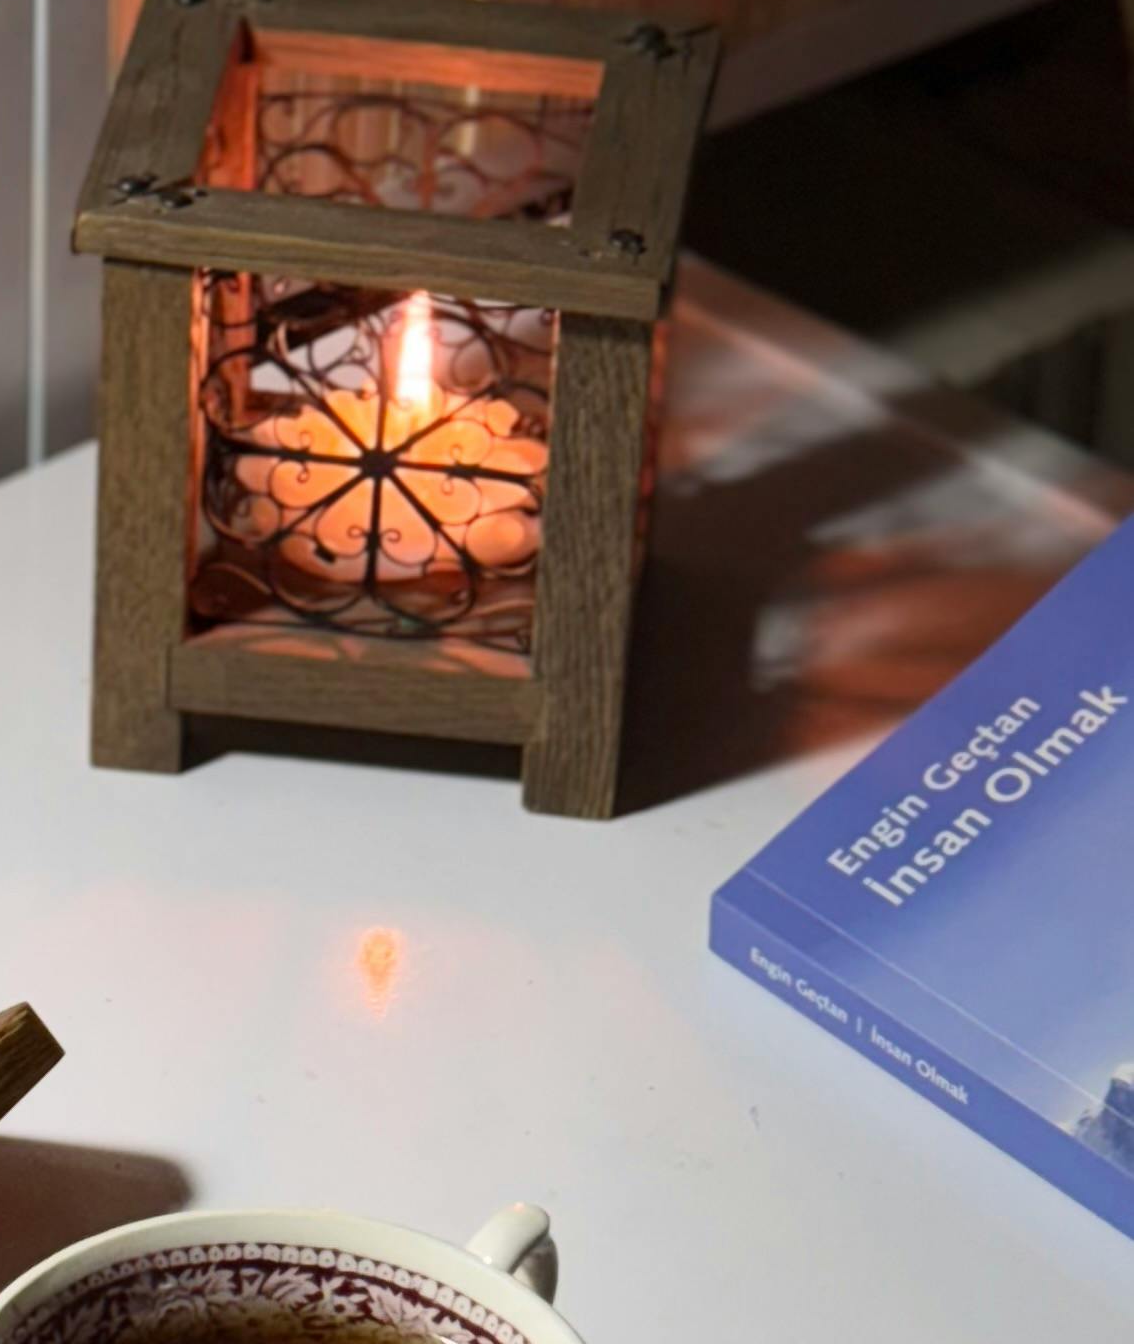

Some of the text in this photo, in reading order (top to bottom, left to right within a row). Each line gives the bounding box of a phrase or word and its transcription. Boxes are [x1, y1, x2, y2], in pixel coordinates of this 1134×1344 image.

[826, 695, 1042, 877] Engin Geçtan
[861, 685, 1129, 907] İnsan Olmak
[749, 946, 969, 1105] Engin Geçtan İnsan Olmak
